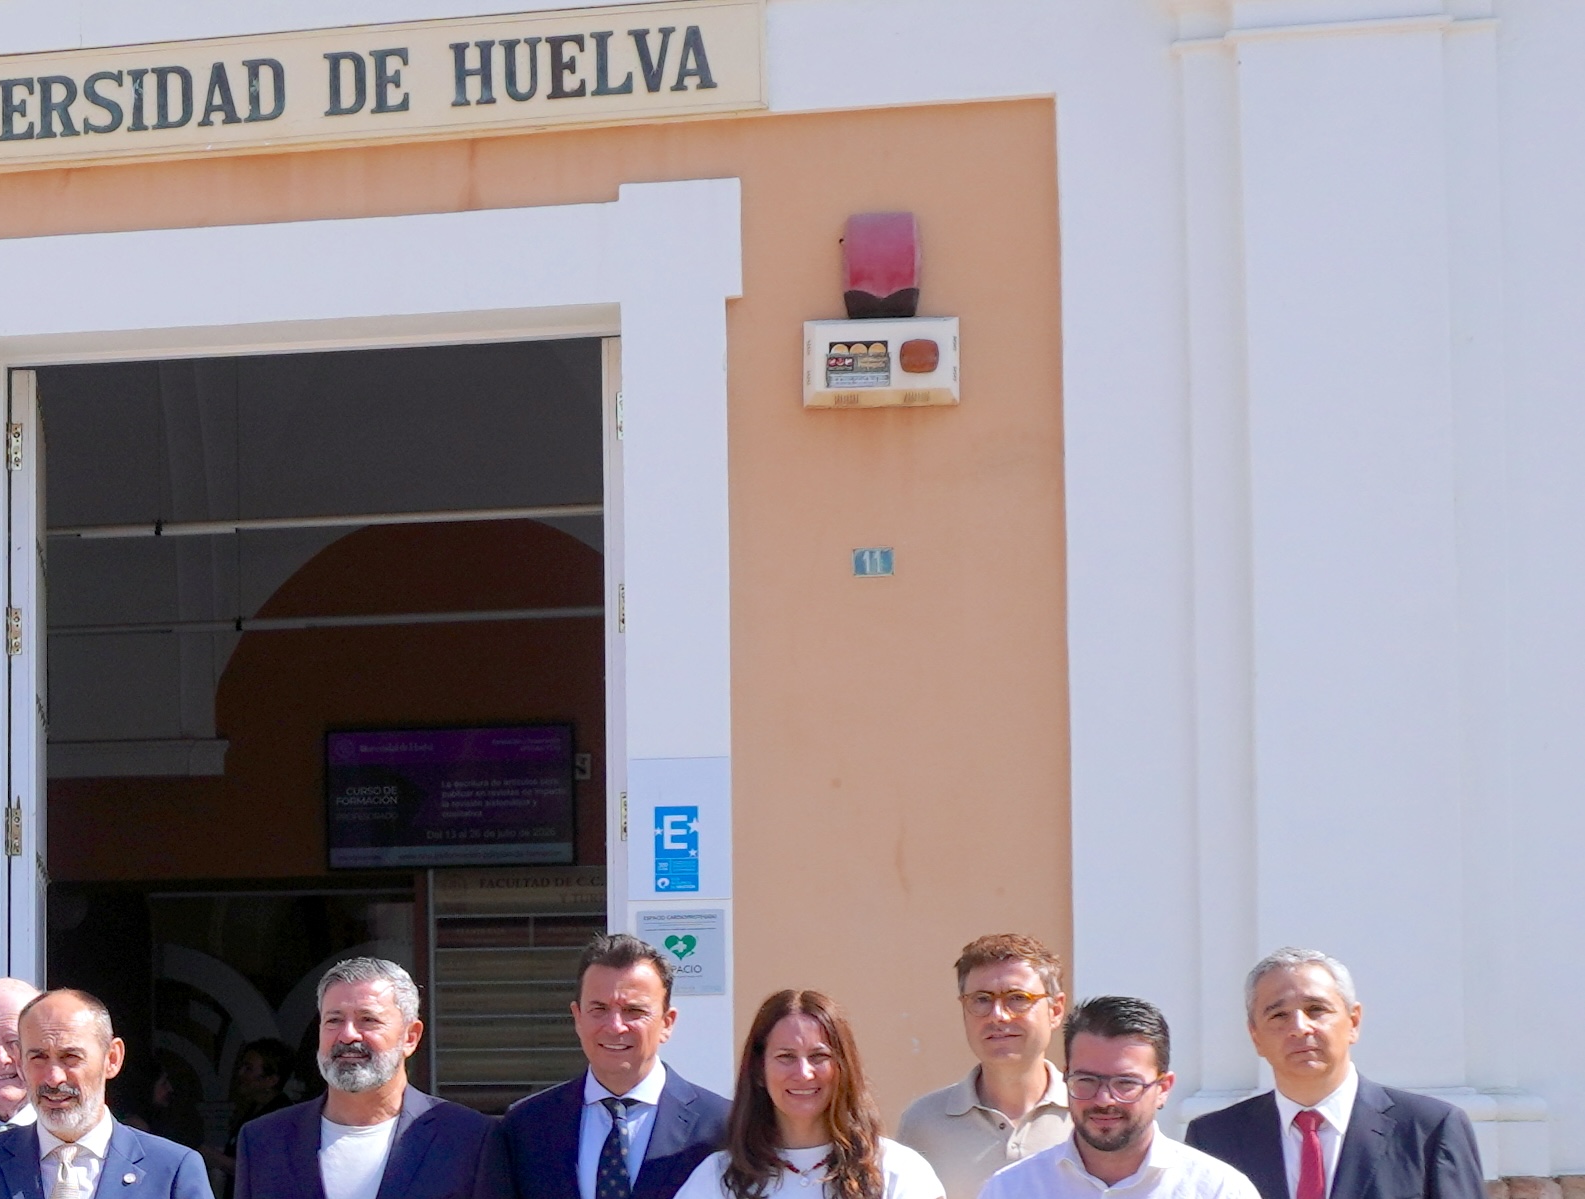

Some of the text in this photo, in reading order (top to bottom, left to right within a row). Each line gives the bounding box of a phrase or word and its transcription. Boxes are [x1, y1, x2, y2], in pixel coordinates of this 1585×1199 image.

[323, 47, 410, 117] DE
[449, 25, 718, 107] HUELVA
[862, 550, 881, 573] 11
[346, 785, 398, 796] CURSO DE
[336, 795, 398, 805] FORMACIÓN
[663, 814, 688, 850] E
[479, 877, 550, 888] FACULTAD
[554, 877, 572, 887] DE
[670, 964, 703, 974] PACIO
